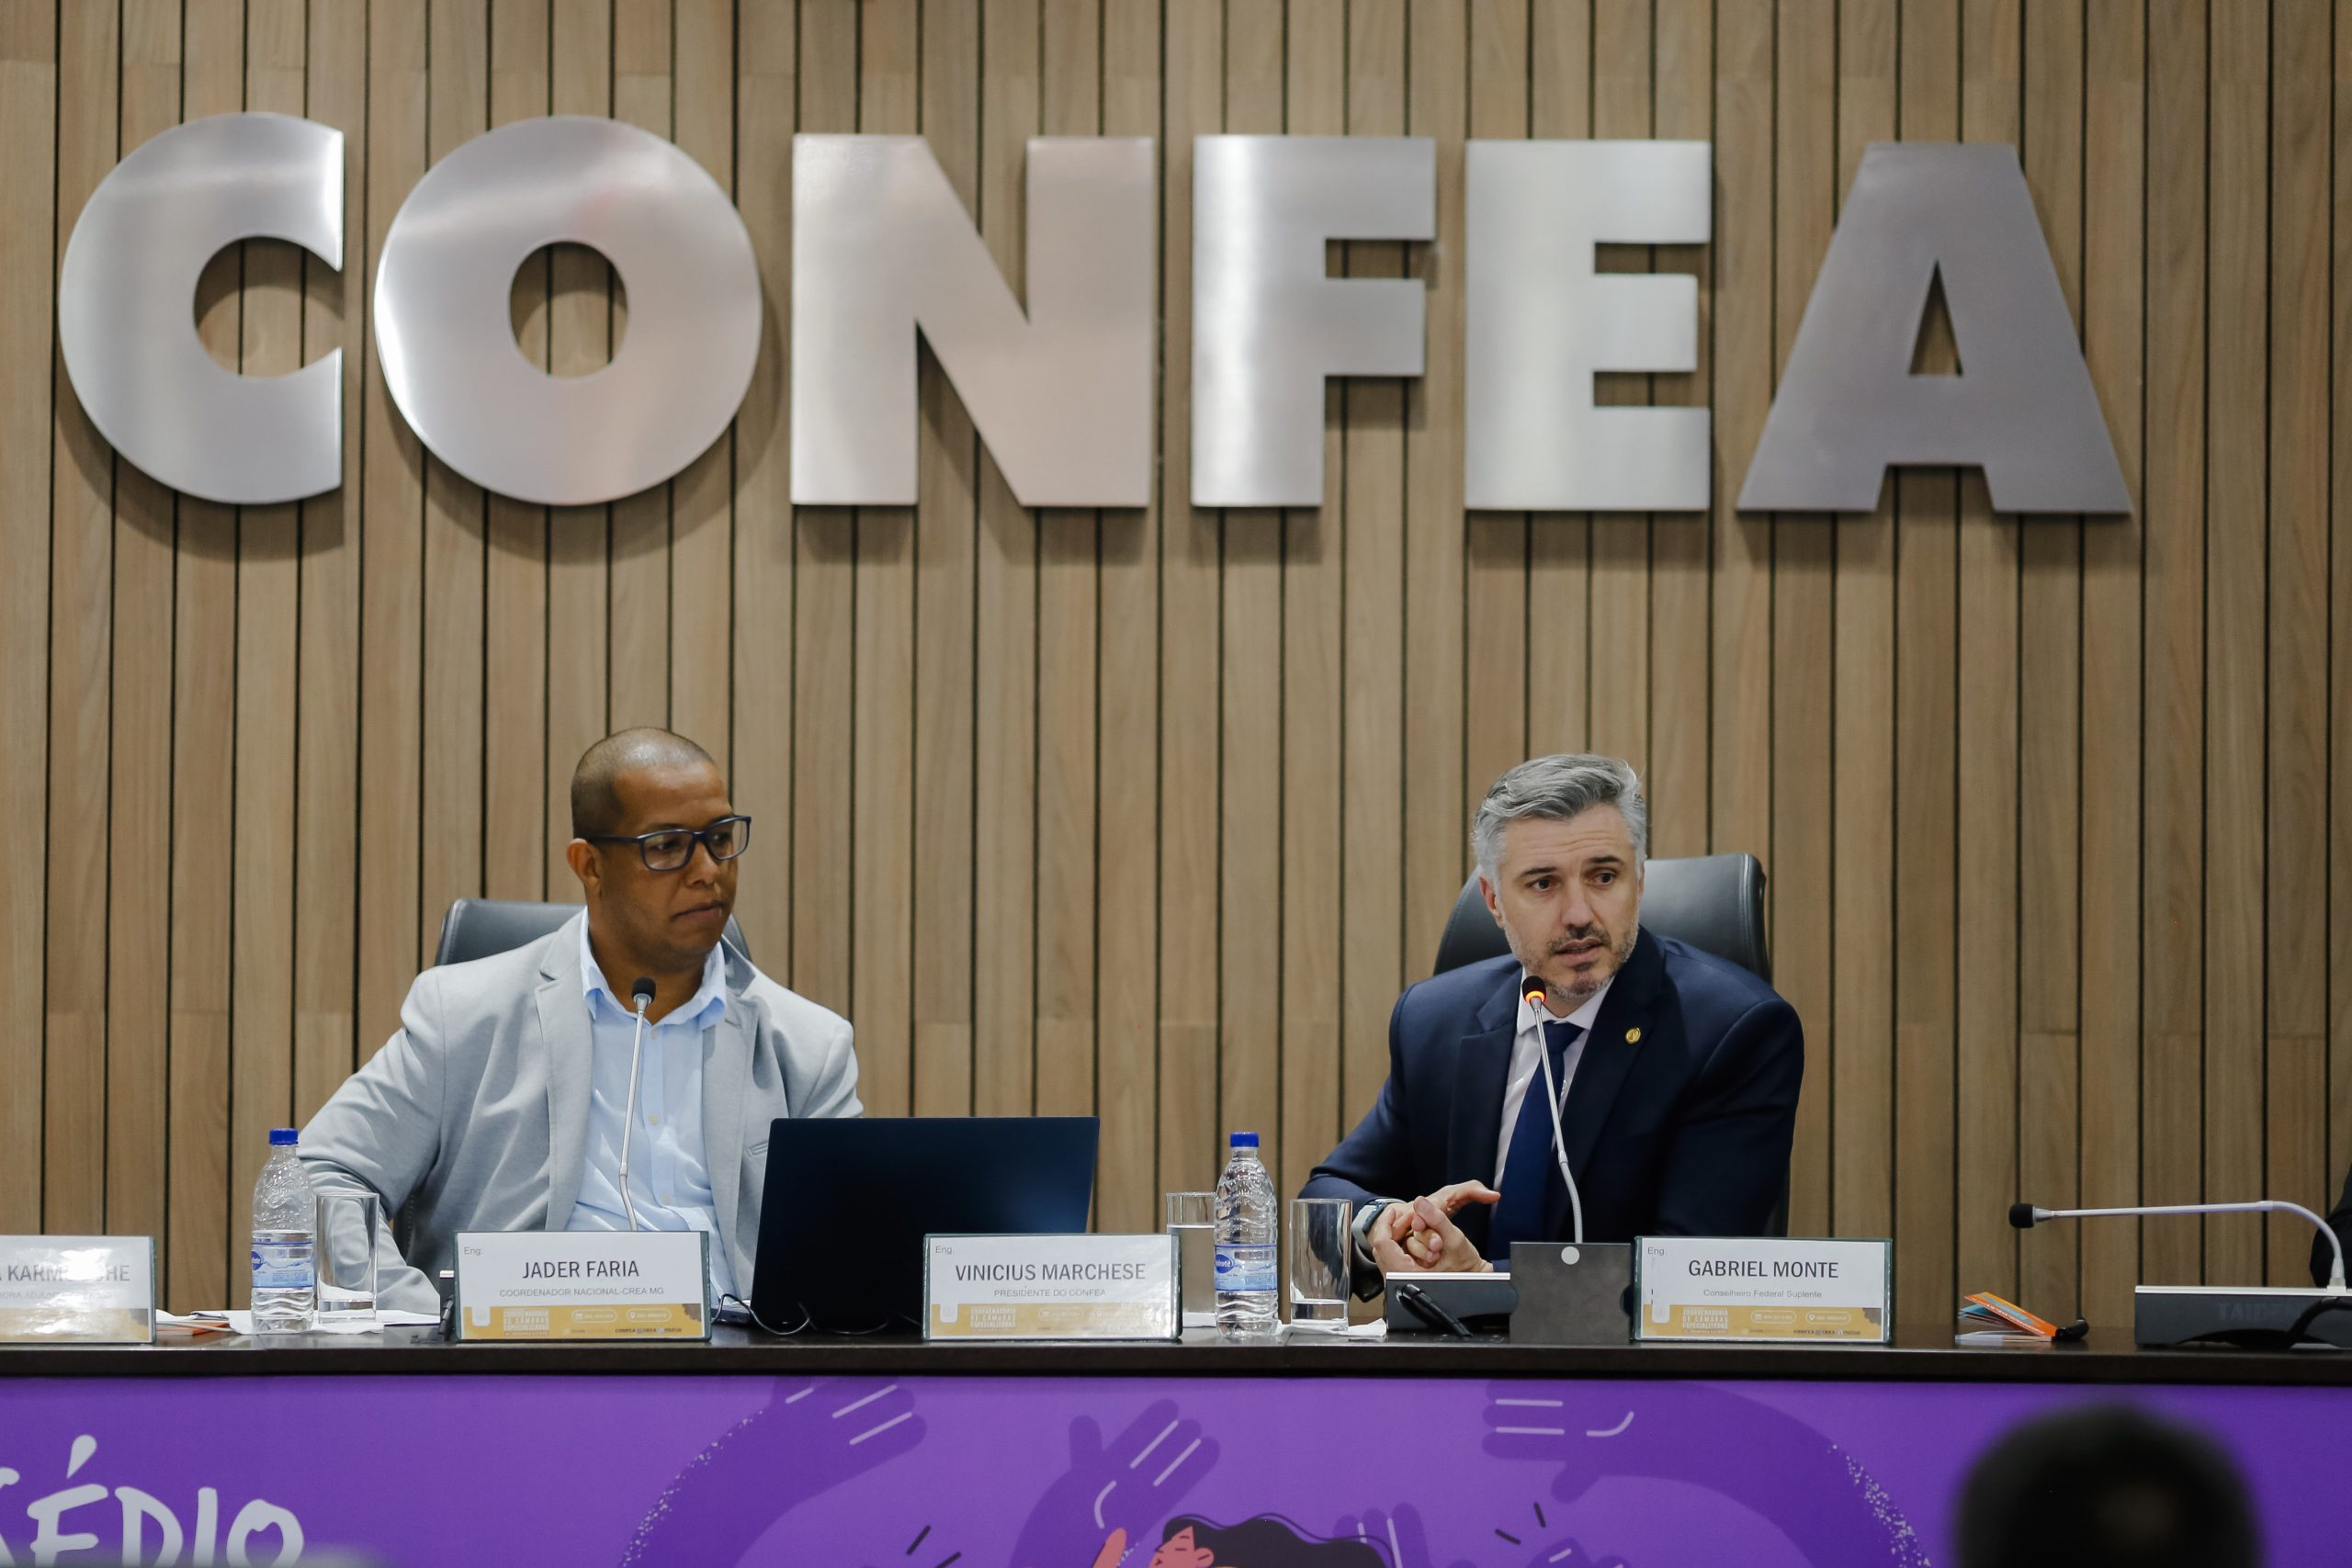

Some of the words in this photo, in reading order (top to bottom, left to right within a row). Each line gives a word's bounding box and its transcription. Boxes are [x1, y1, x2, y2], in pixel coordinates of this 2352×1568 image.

[59, 110, 2134, 514] CONFEA
[464, 1247, 484, 1257] Eng.
[935, 1246, 956, 1256] Eng.
[1647, 1247, 1668, 1257] Eng.
[522, 1261, 581, 1280] JADER
[586, 1260, 639, 1278] FARIA
[955, 1264, 1037, 1281] VINICIUS
[1042, 1263, 1147, 1280] MARCHESE
[1688, 1259, 1769, 1278] GABRIEL
[1773, 1261, 1839, 1279] MONTE
[499, 1288, 571, 1297] COORDENADOR
[649, 1287, 664, 1295] MG
[994, 1289, 1051, 1297] PRESIDENTE
[1053, 1289, 1067, 1297] DO
[1069, 1288, 1106, 1297] CONFEA
[1702, 1288, 1751, 1298] Conselheiro
[1753, 1289, 1784, 1298] Federal
[1786, 1290, 1823, 1300] Suplente
